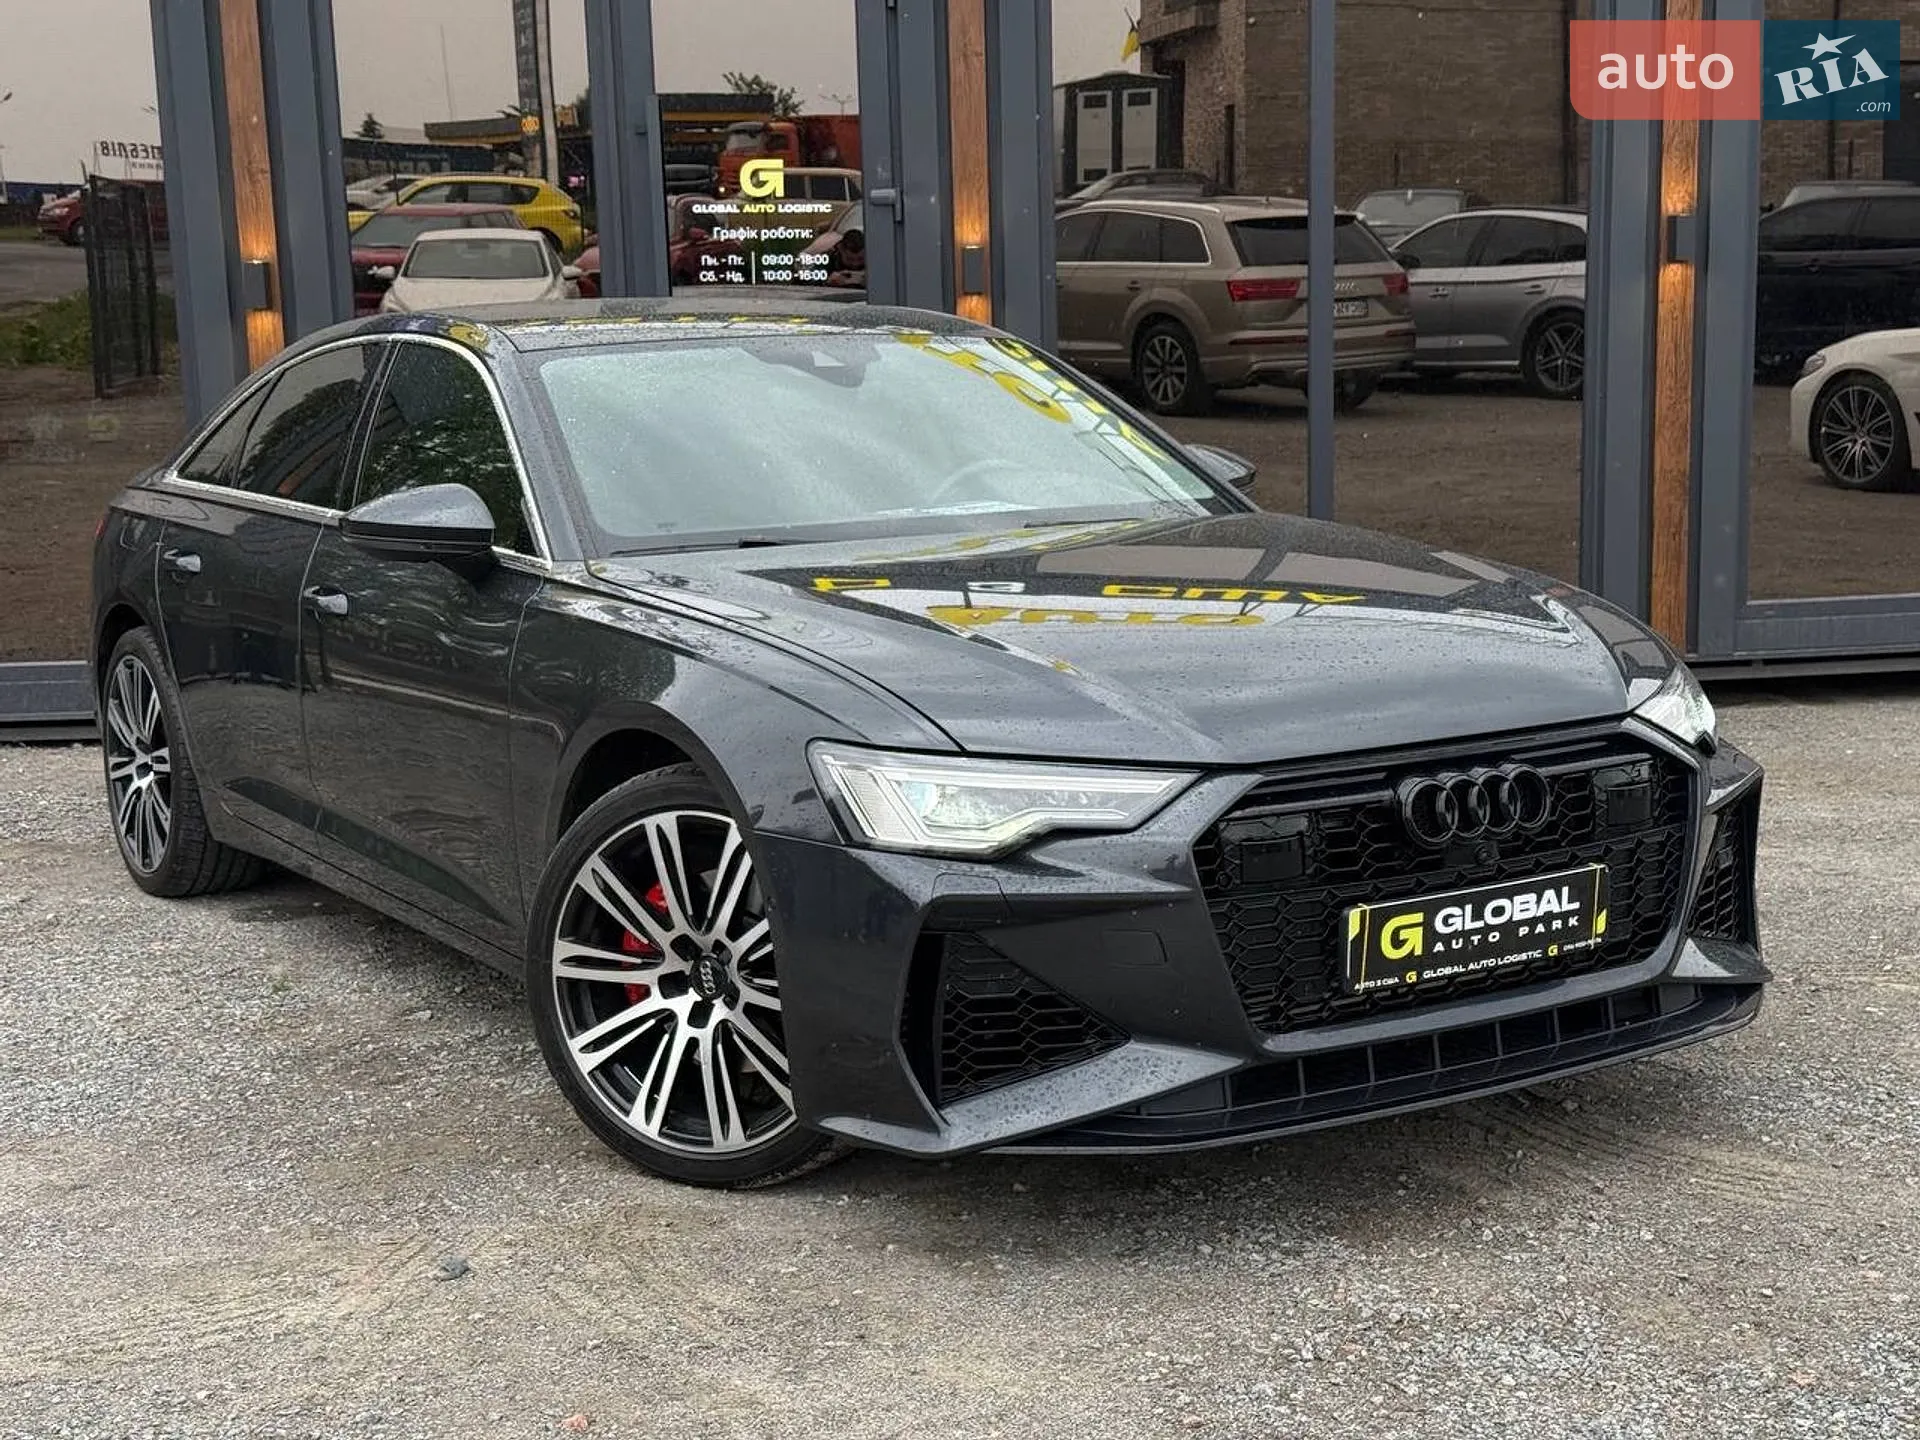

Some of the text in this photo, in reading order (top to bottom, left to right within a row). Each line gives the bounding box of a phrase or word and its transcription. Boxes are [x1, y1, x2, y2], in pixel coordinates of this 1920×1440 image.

[692, 204, 832, 214] GLOBAL AUTO LOGISTIC
[713, 227, 813, 240] Графік роботи:
[761, 254, 794, 265] 09:00
[762, 270, 792, 281] 10:00
[1434, 886, 1581, 935] GLOBAL
[1433, 915, 1580, 953] AUTO PARK
[1423, 965, 1465, 979] GLOBAL
[1467, 958, 1497, 971] AUTO
[1497, 949, 1543, 966] LOGISTIC
